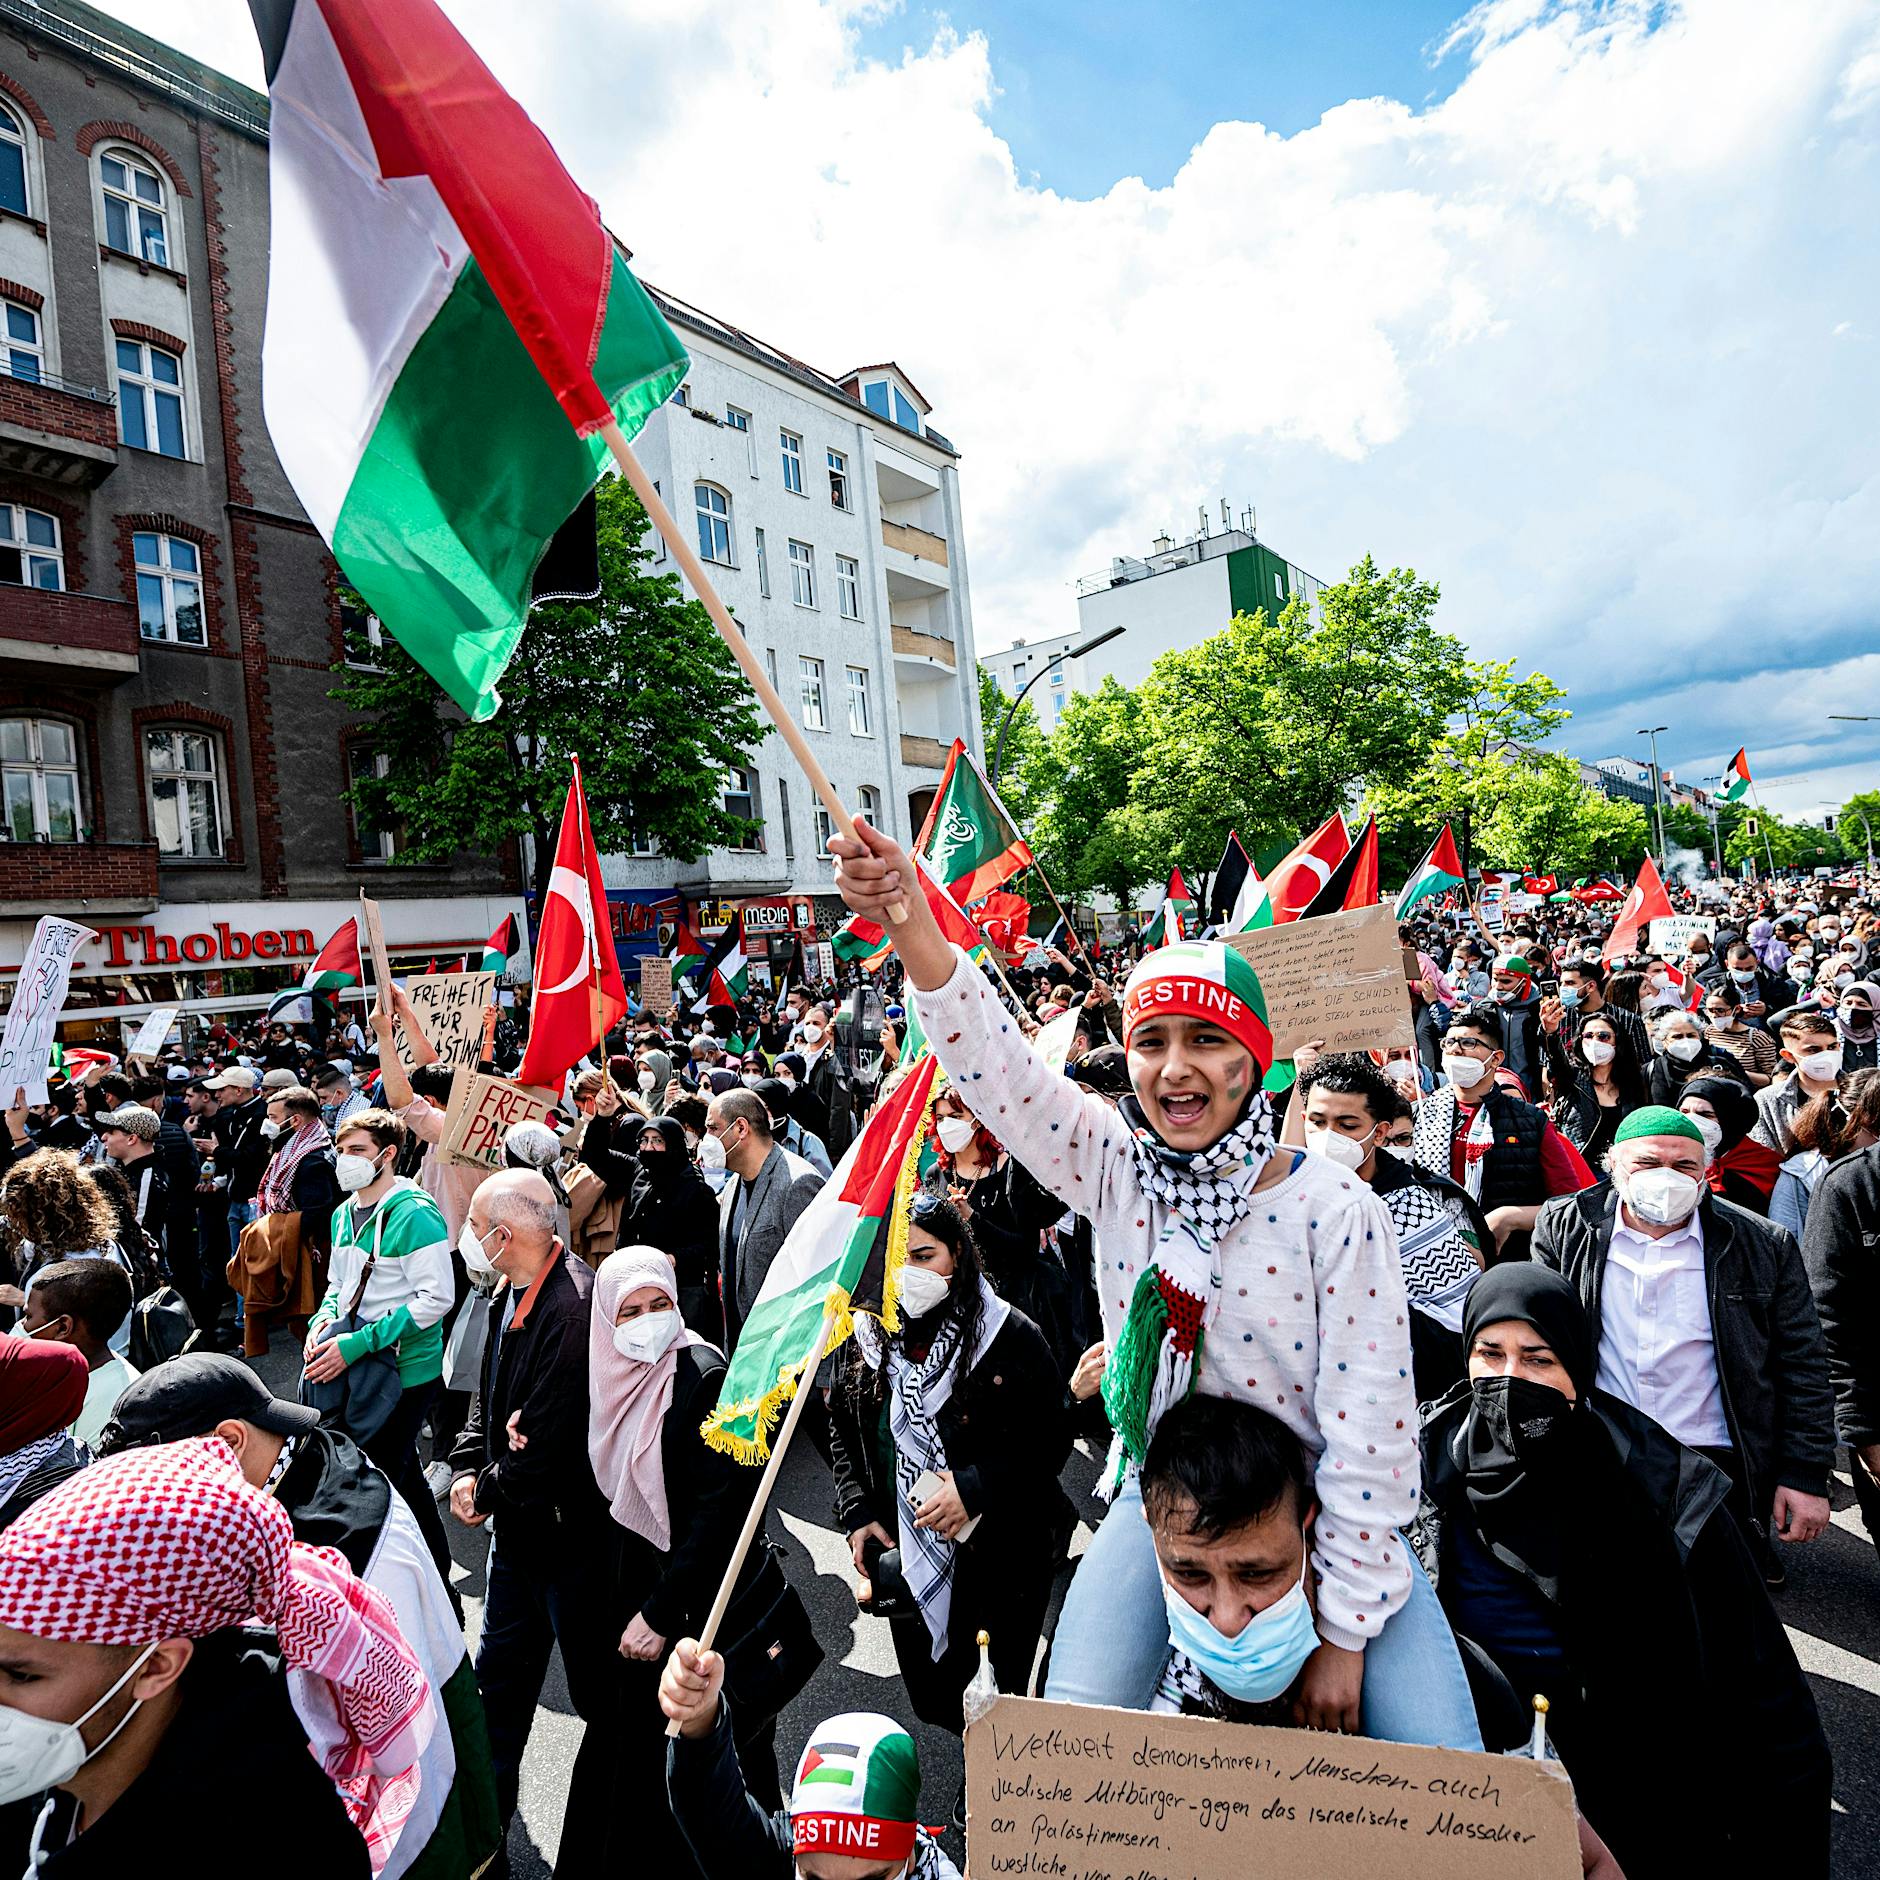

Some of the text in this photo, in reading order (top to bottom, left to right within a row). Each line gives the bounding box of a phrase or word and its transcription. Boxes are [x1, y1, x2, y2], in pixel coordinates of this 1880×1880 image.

[745, 907, 790, 925] MEDIA
[1658, 919, 1709, 929] PALESTINIAN
[41, 925, 80, 958] FREE
[93, 922, 319, 967] Thoben
[412, 976, 491, 1008] FREIHEIT
[1292, 1000, 1317, 1011] ABER
[1324, 993, 1344, 1006] DIE
[431, 1005, 462, 1033] FÜR
[1288, 1016, 1320, 1028] EINEN
[1325, 1010, 1354, 1022] STEIN
[1334, 1027, 1383, 1046] Palestine
[396, 1026, 484, 1073] PÄSTINA
[479, 1085, 543, 1125] FREE
[992, 1724, 1114, 1761] Weltweit
[1428, 1775, 1501, 1807] auch
[1262, 1798, 1296, 1820] das
[991, 1817, 1016, 1834] an
